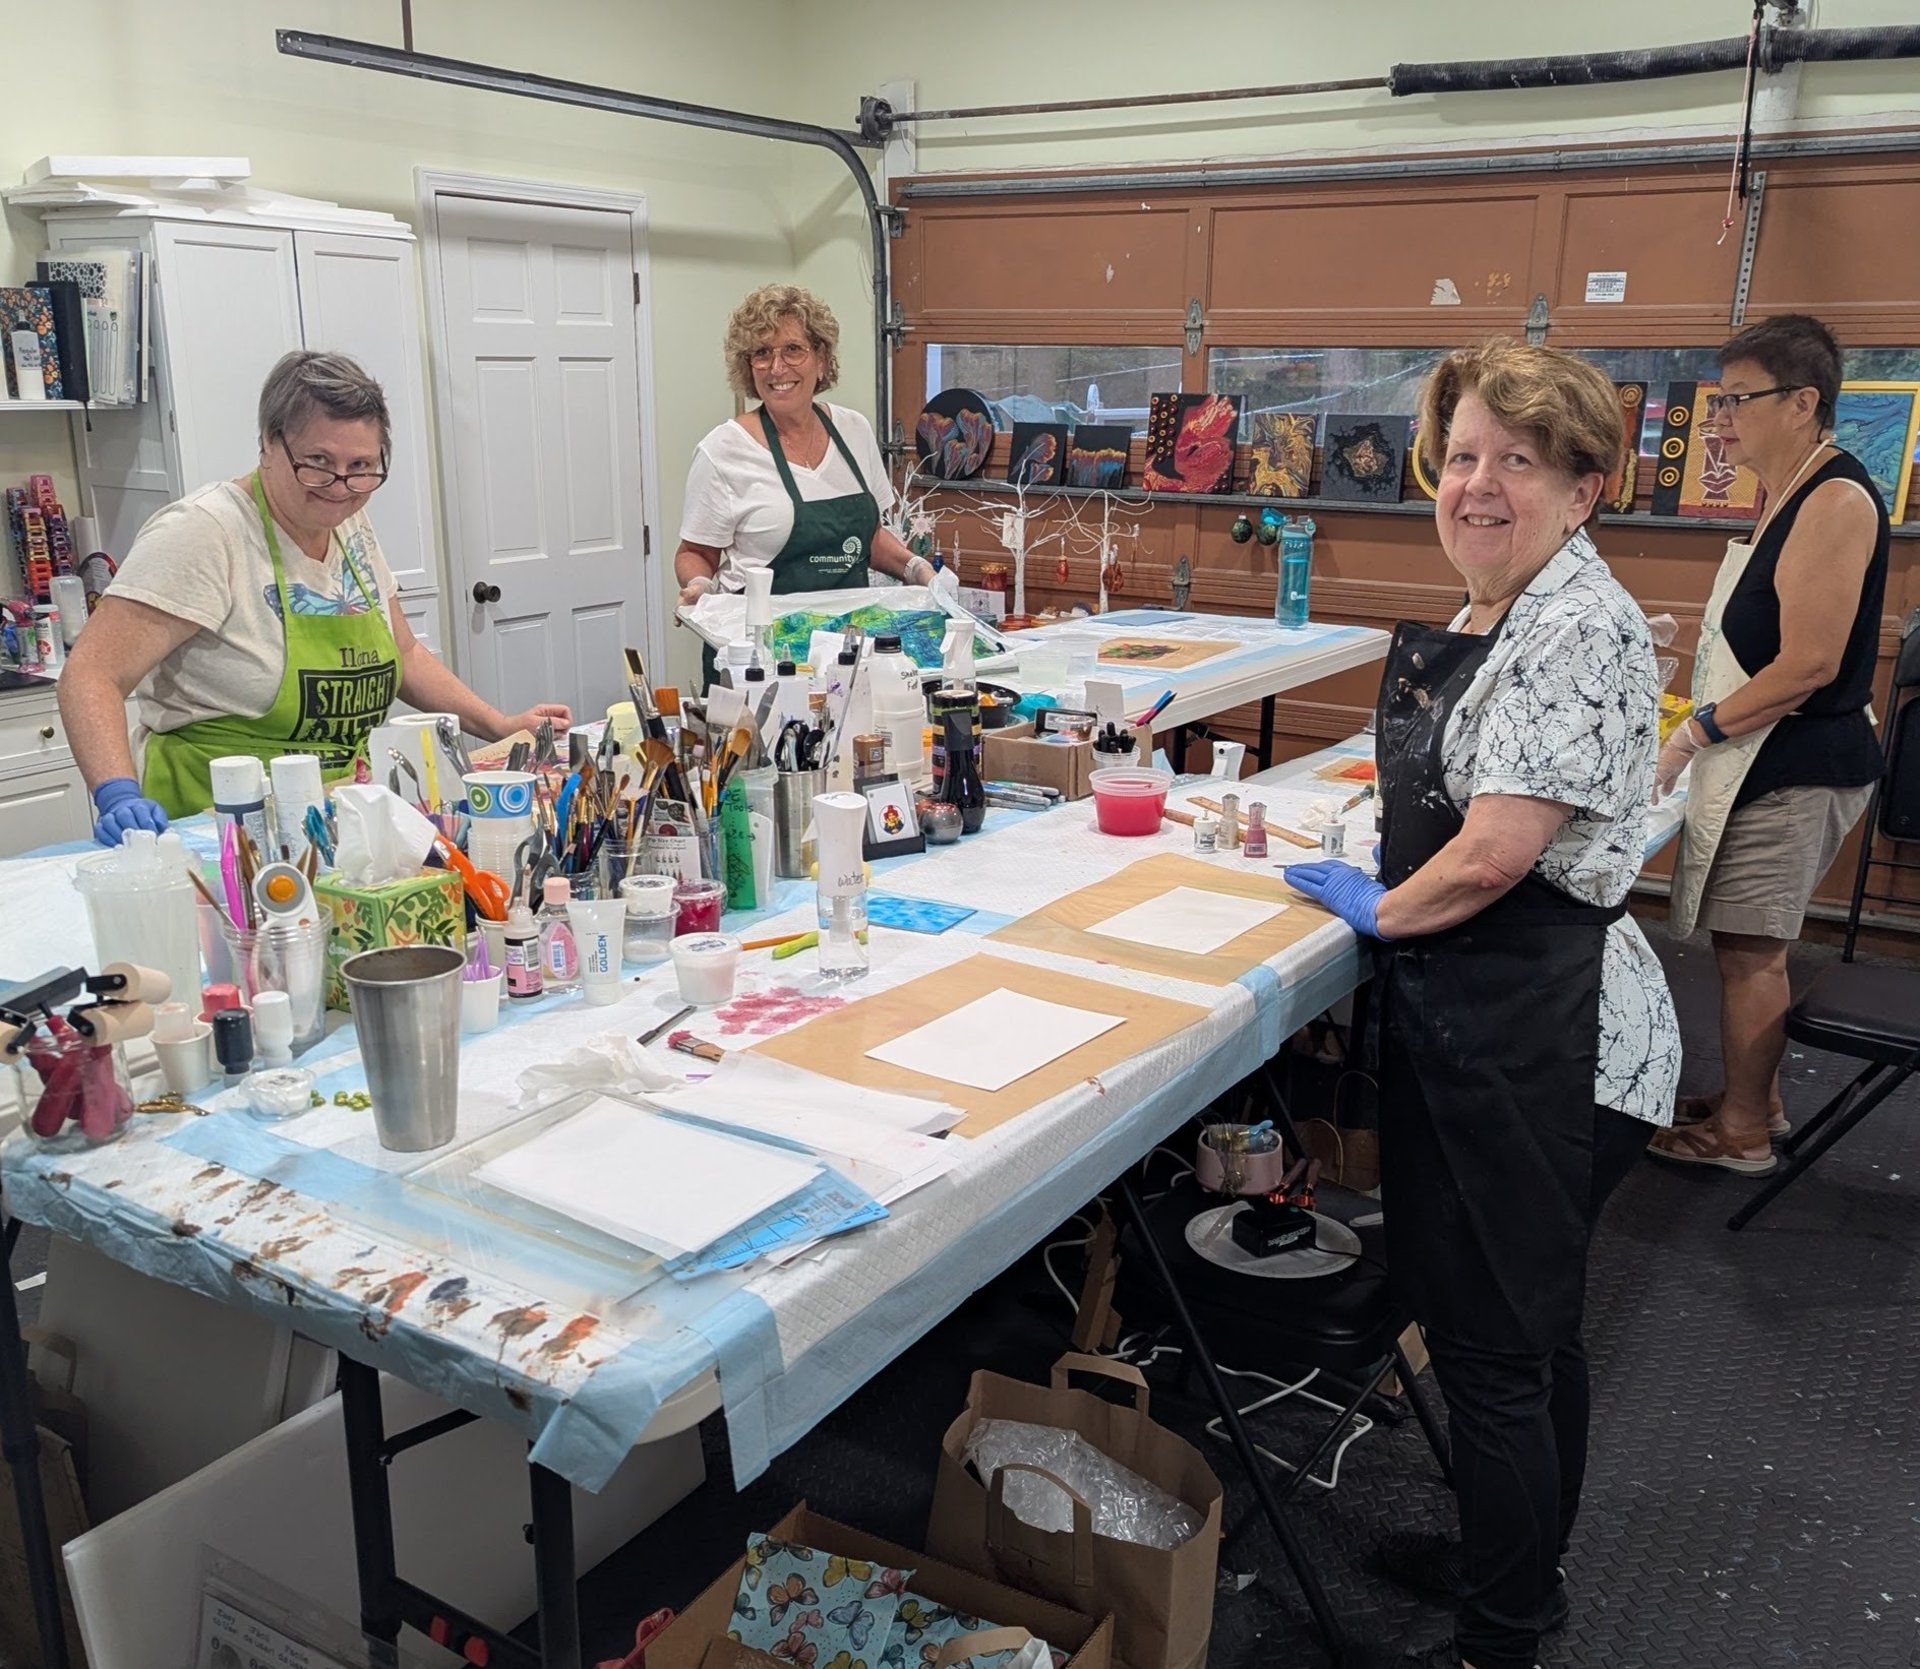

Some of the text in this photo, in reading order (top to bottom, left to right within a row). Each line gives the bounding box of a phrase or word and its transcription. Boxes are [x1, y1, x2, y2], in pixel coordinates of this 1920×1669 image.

[809, 554, 856, 564] community
[339, 647, 381, 668] Ilona
[316, 673, 393, 715] STRAIGHT
[598, 934, 609, 973] GOLDEN
